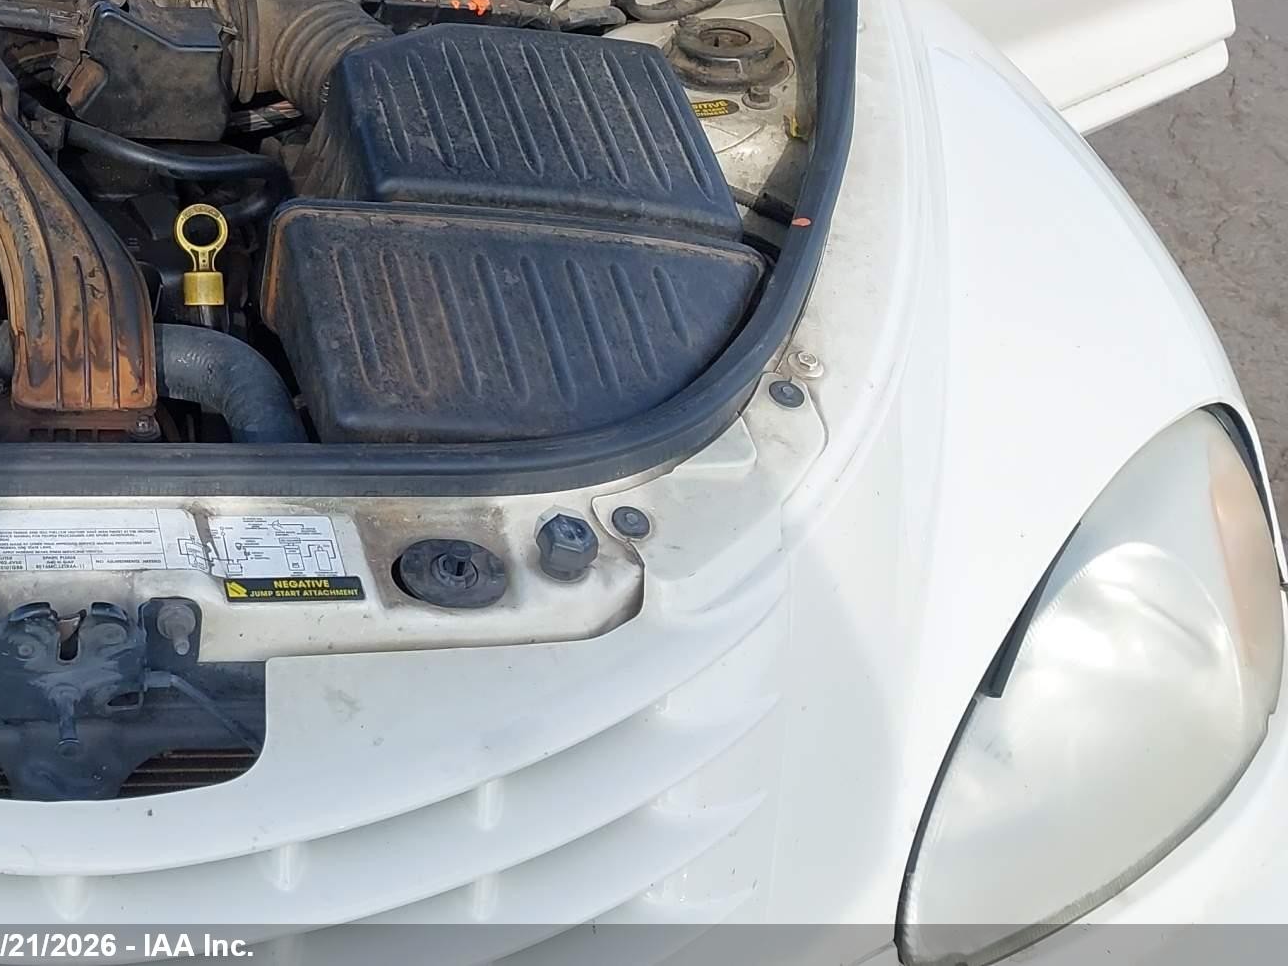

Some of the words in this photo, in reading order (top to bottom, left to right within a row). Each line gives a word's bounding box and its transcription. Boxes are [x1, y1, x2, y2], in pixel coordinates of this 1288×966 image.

[273, 579, 330, 589] NEGATIVE
[250, 590, 274, 598] JUMP
[274, 589, 302, 597] START
[302, 588, 359, 597] ATTACHMENT
